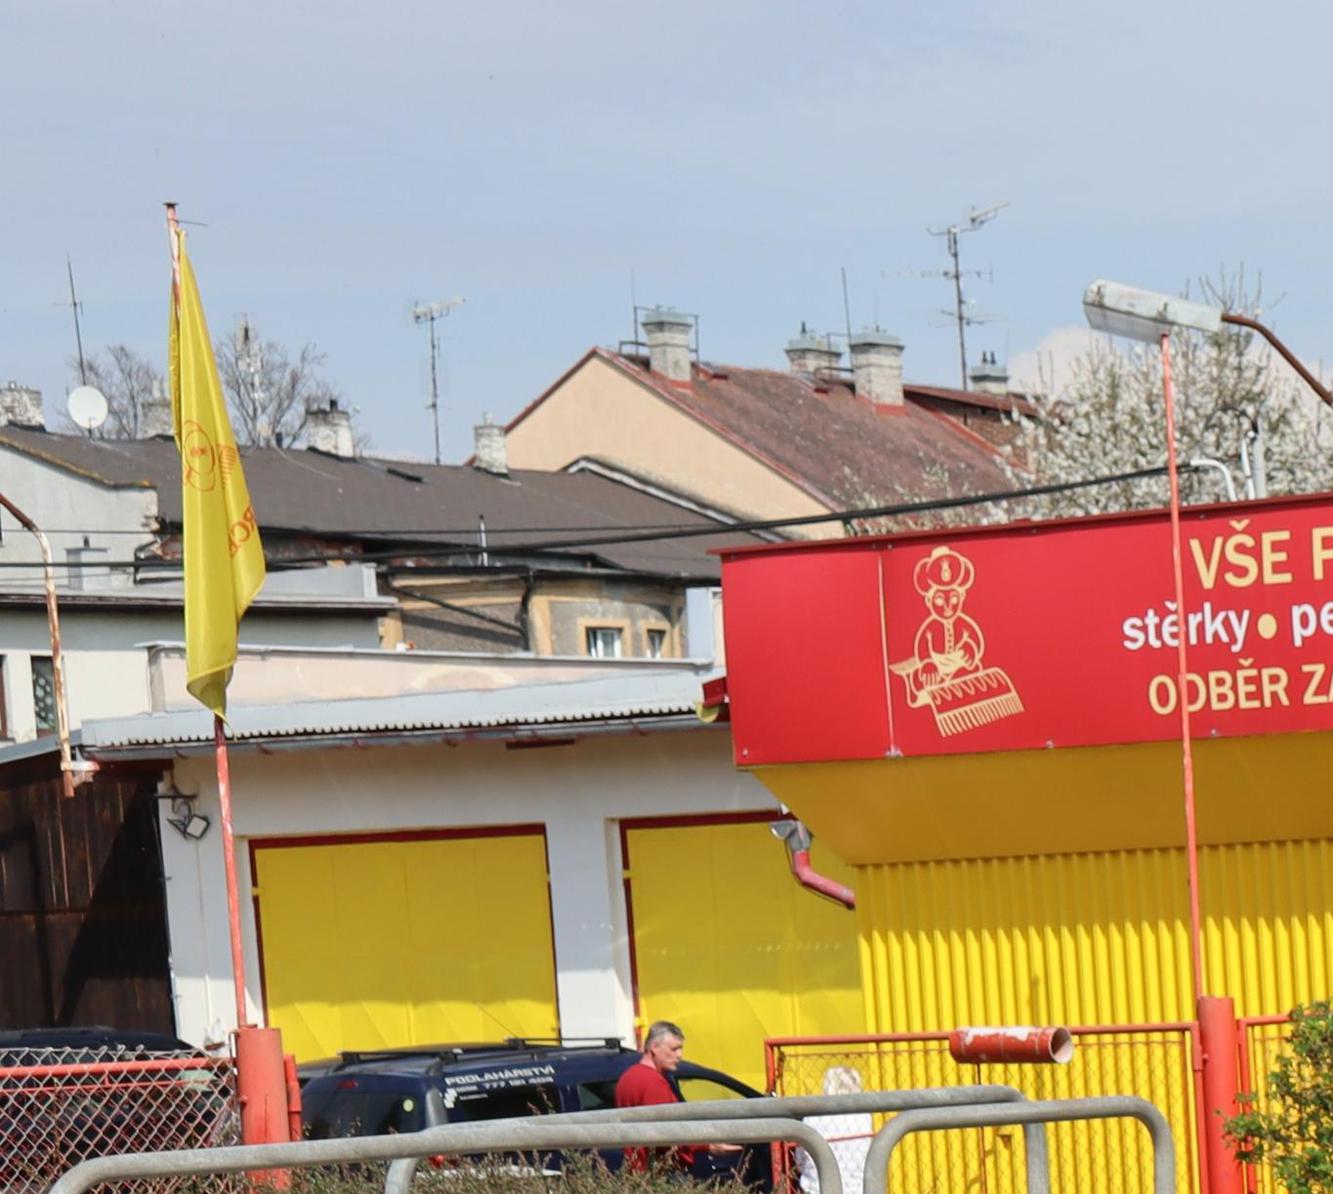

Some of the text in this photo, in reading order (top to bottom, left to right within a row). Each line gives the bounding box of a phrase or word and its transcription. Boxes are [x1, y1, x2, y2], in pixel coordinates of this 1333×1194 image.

[1189, 519, 1293, 590] VŠE
[1122, 600, 1250, 653] stěrky
[1148, 658, 1291, 716] ODBĚR
